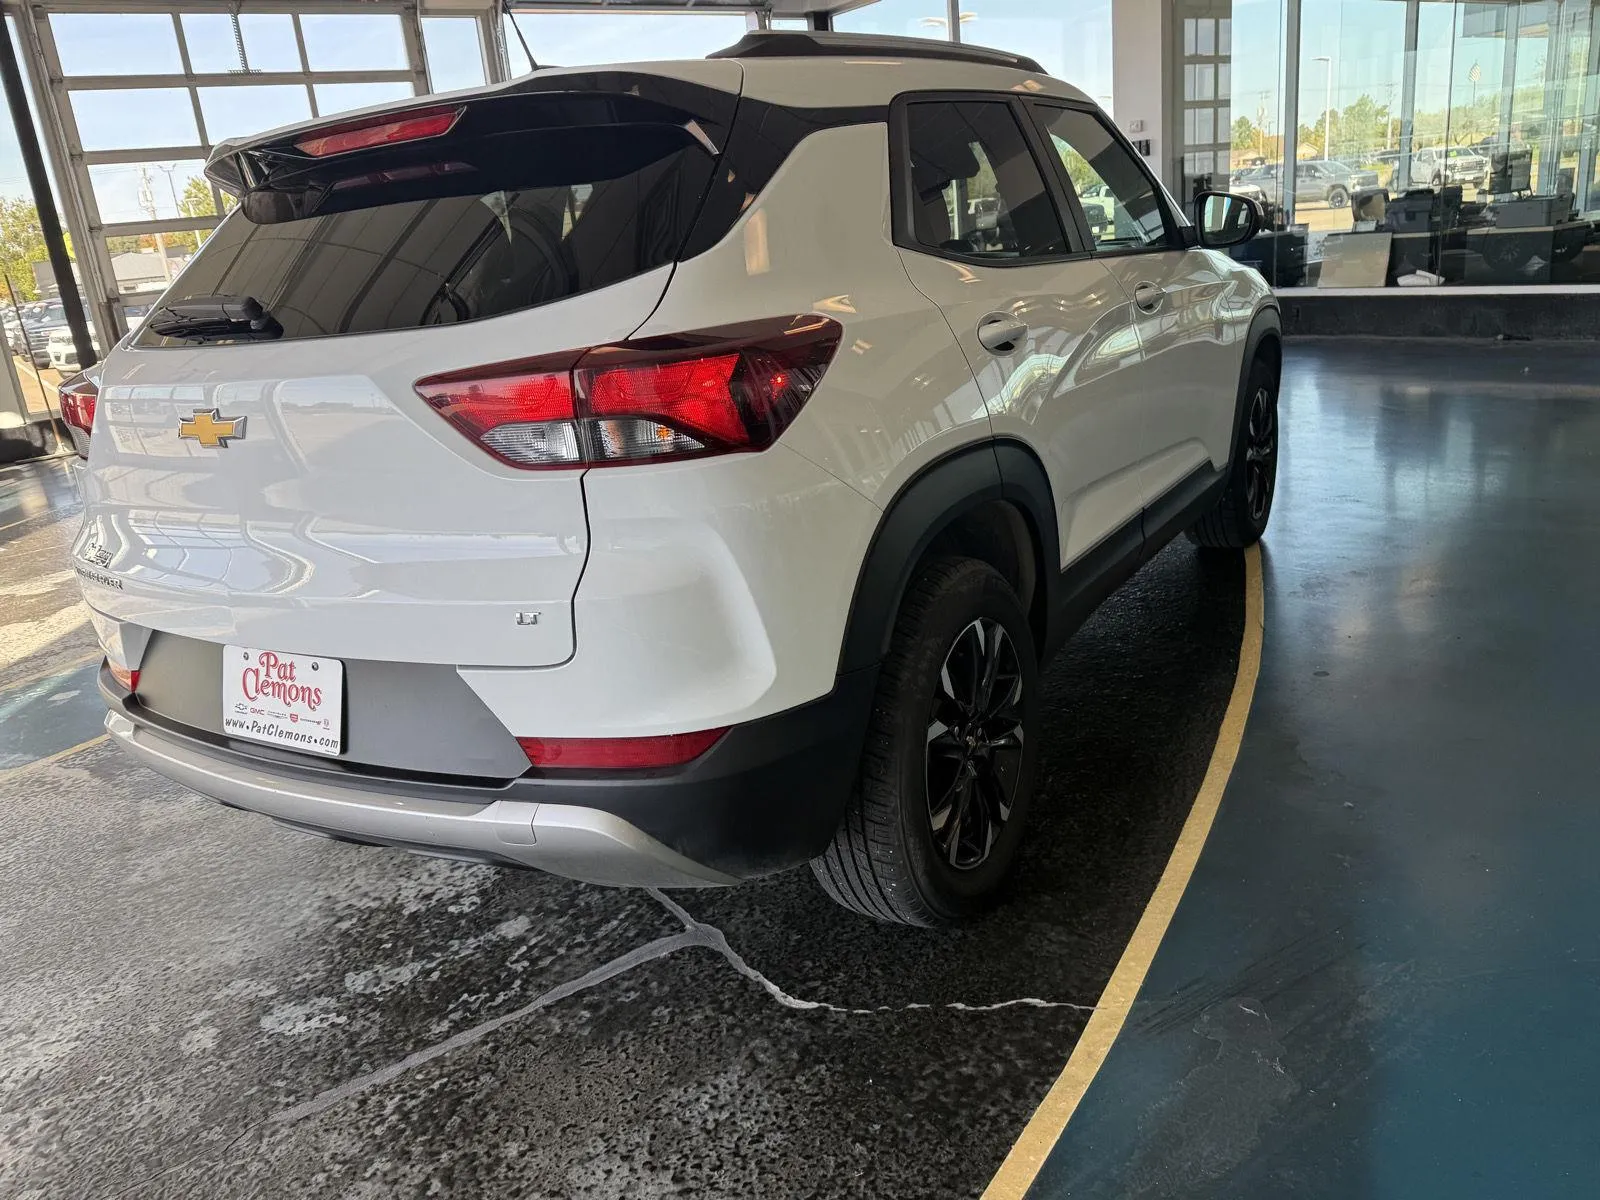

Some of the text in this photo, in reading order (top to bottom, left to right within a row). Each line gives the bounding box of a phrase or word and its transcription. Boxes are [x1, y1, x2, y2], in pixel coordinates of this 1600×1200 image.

[516, 611, 541, 625] LT
[259, 651, 297, 682] Pat
[242, 667, 322, 711] Clemons
[250, 707, 265, 716] GMC
